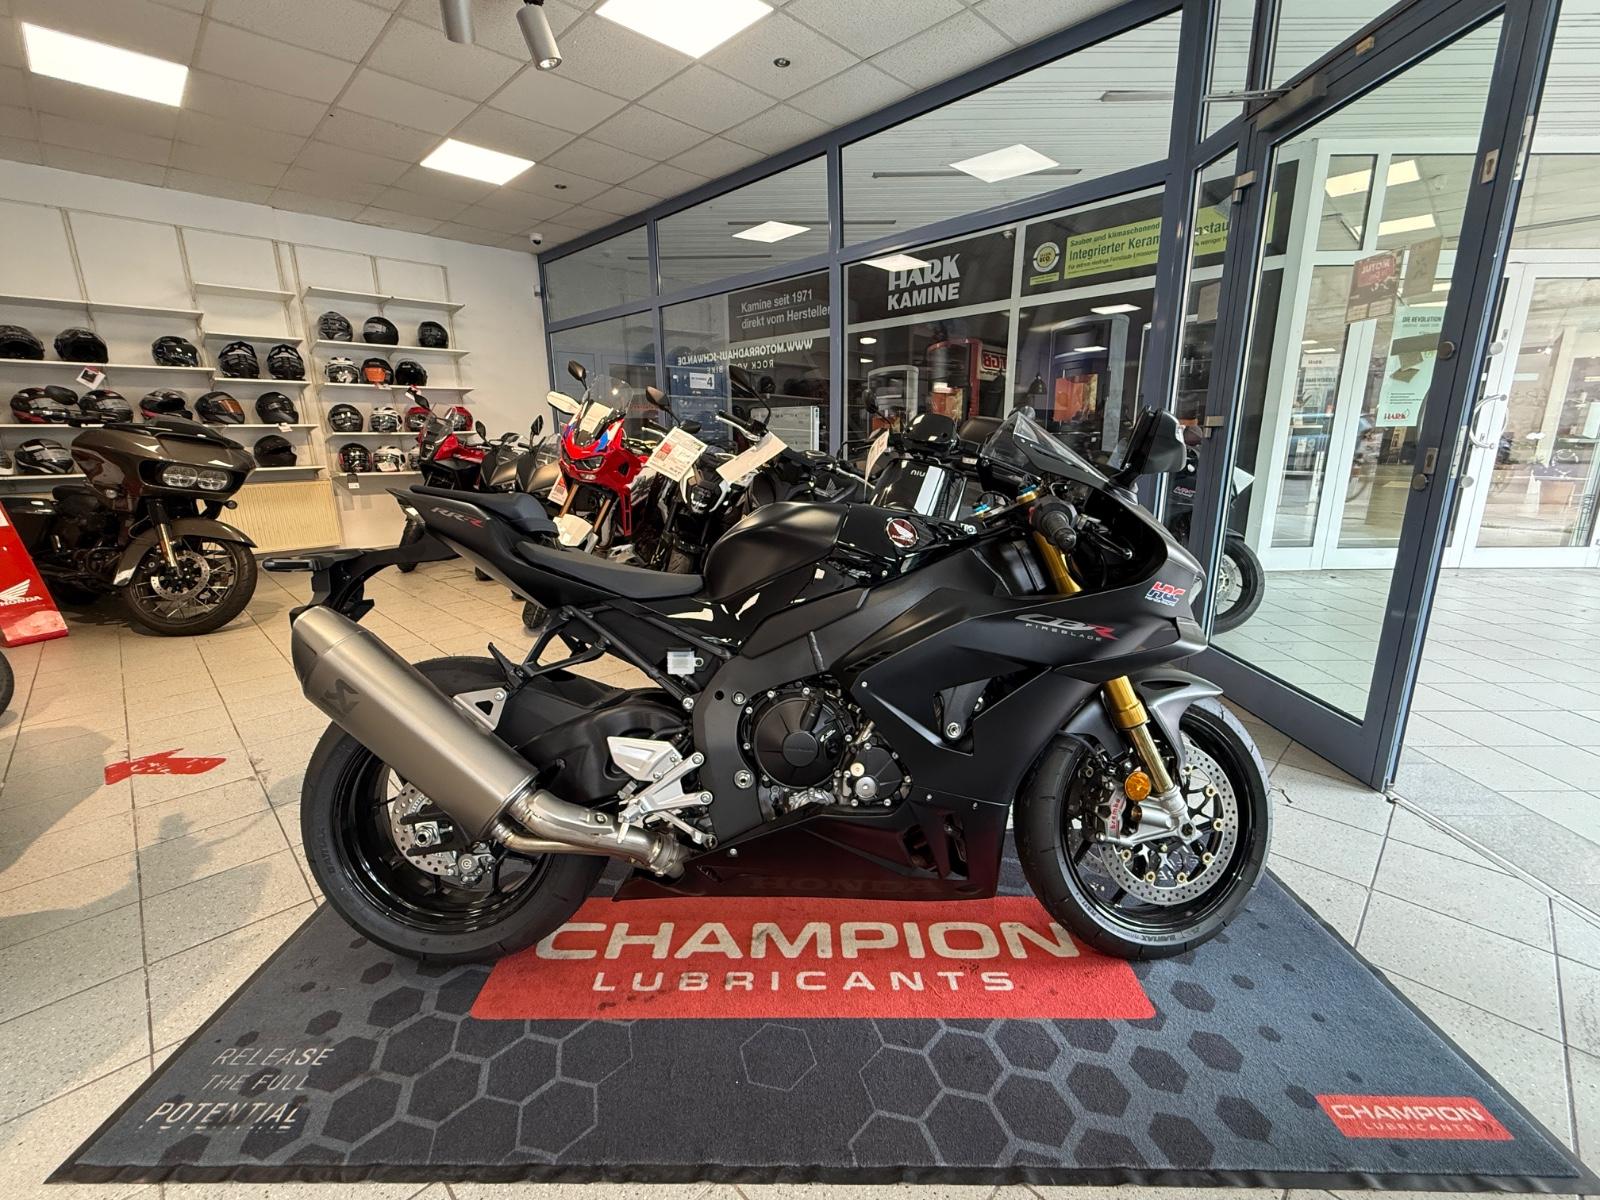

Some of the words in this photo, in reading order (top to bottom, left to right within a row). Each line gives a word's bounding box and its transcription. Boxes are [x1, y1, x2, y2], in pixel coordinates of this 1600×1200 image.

[1094, 234, 1107, 242] und
[1069, 241, 1125, 262] Integrierter
[888, 253, 961, 291] HARK
[741, 299, 772, 313] Kamine
[773, 294, 790, 307] seit
[792, 288, 813, 303] 1971
[887, 282, 960, 311] KAMINE
[741, 316, 765, 329] direkt
[766, 314, 785, 325] vom
[910, 469, 926, 477] niu
[1025, 623, 1102, 642] FIREBLADE
[535, 921, 1080, 960] CHAMPION
[592, 971, 1015, 992] LUBRICANTS
[211, 1048, 335, 1066] RELEASE
[201, 1074, 250, 1091] THE
[251, 1074, 310, 1091] FULL
[145, 1102, 301, 1123] POTENTIAL
[1331, 1104, 1486, 1122] CHAMPION
[1363, 1122, 1477, 1133] LUBRICANTS
